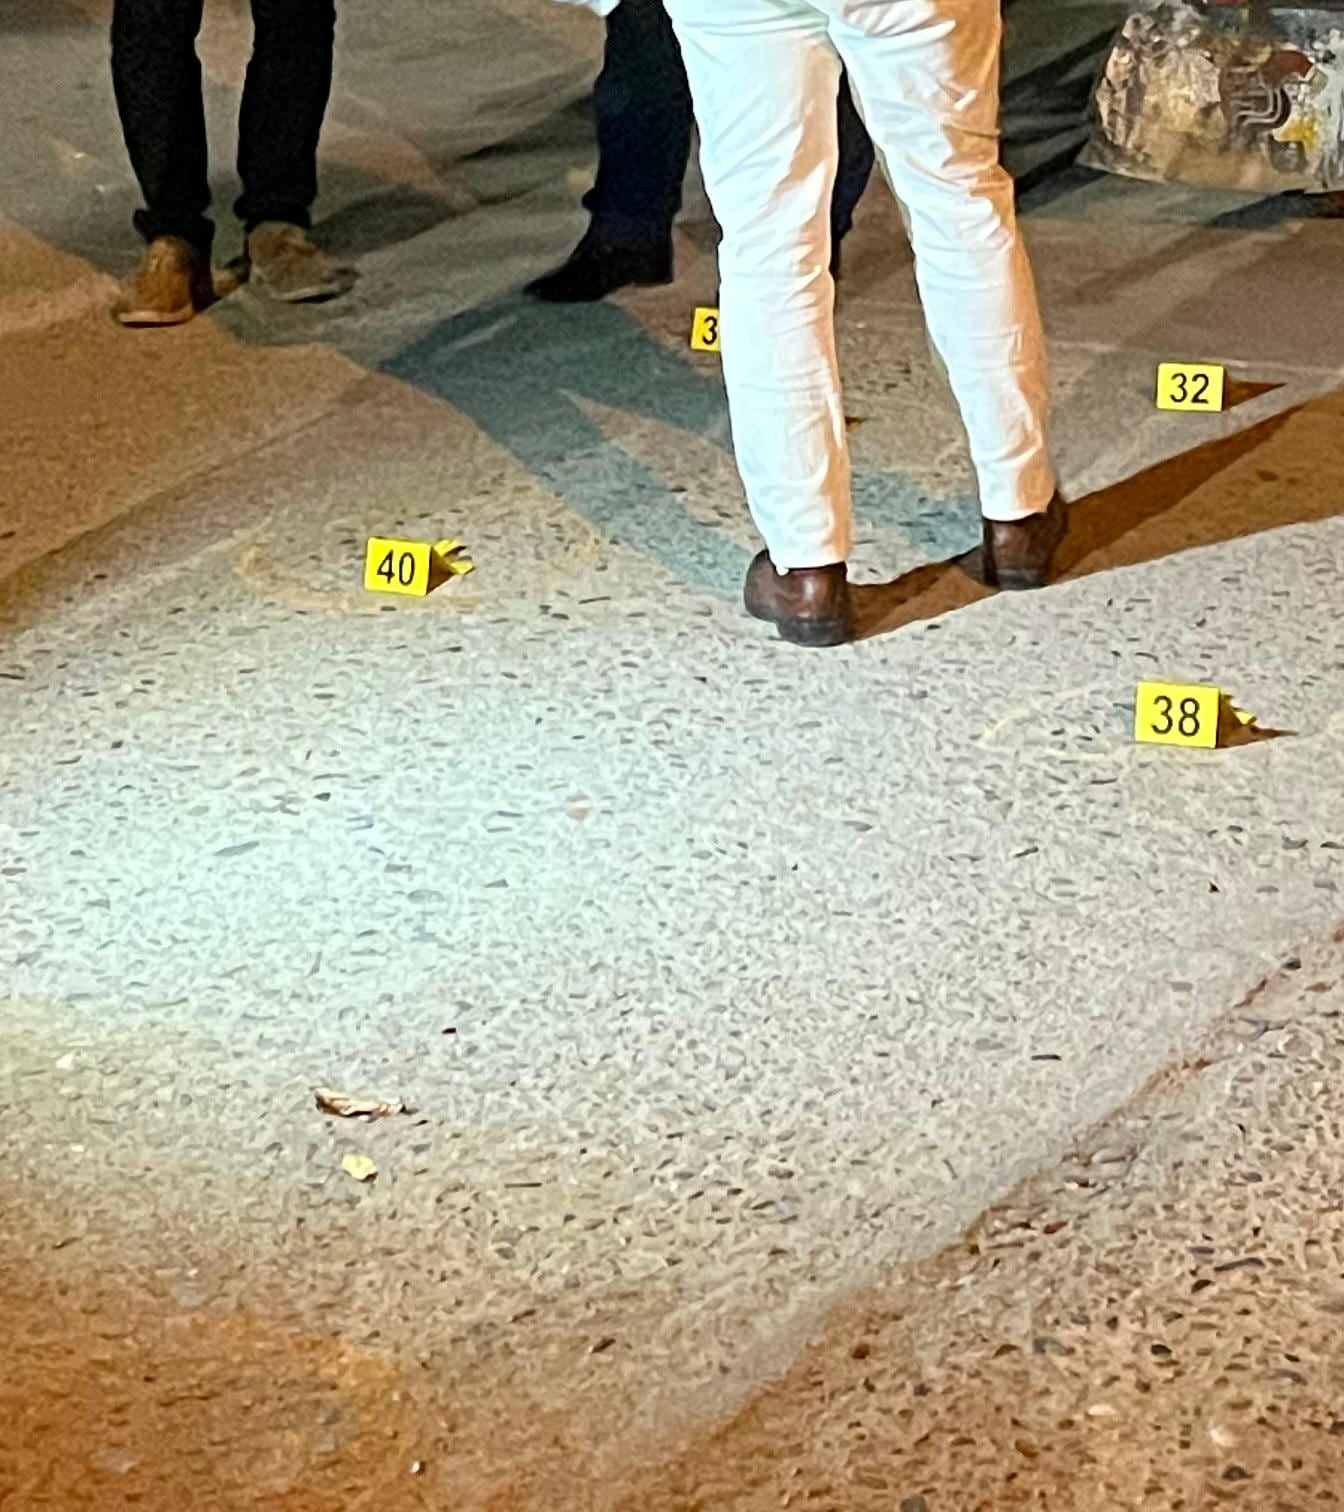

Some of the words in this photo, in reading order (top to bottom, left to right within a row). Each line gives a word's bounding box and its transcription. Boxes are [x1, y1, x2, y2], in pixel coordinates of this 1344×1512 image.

[1170, 372, 1209, 404] 32
[377, 549, 415, 586] 40
[1151, 695, 1200, 737] 38
